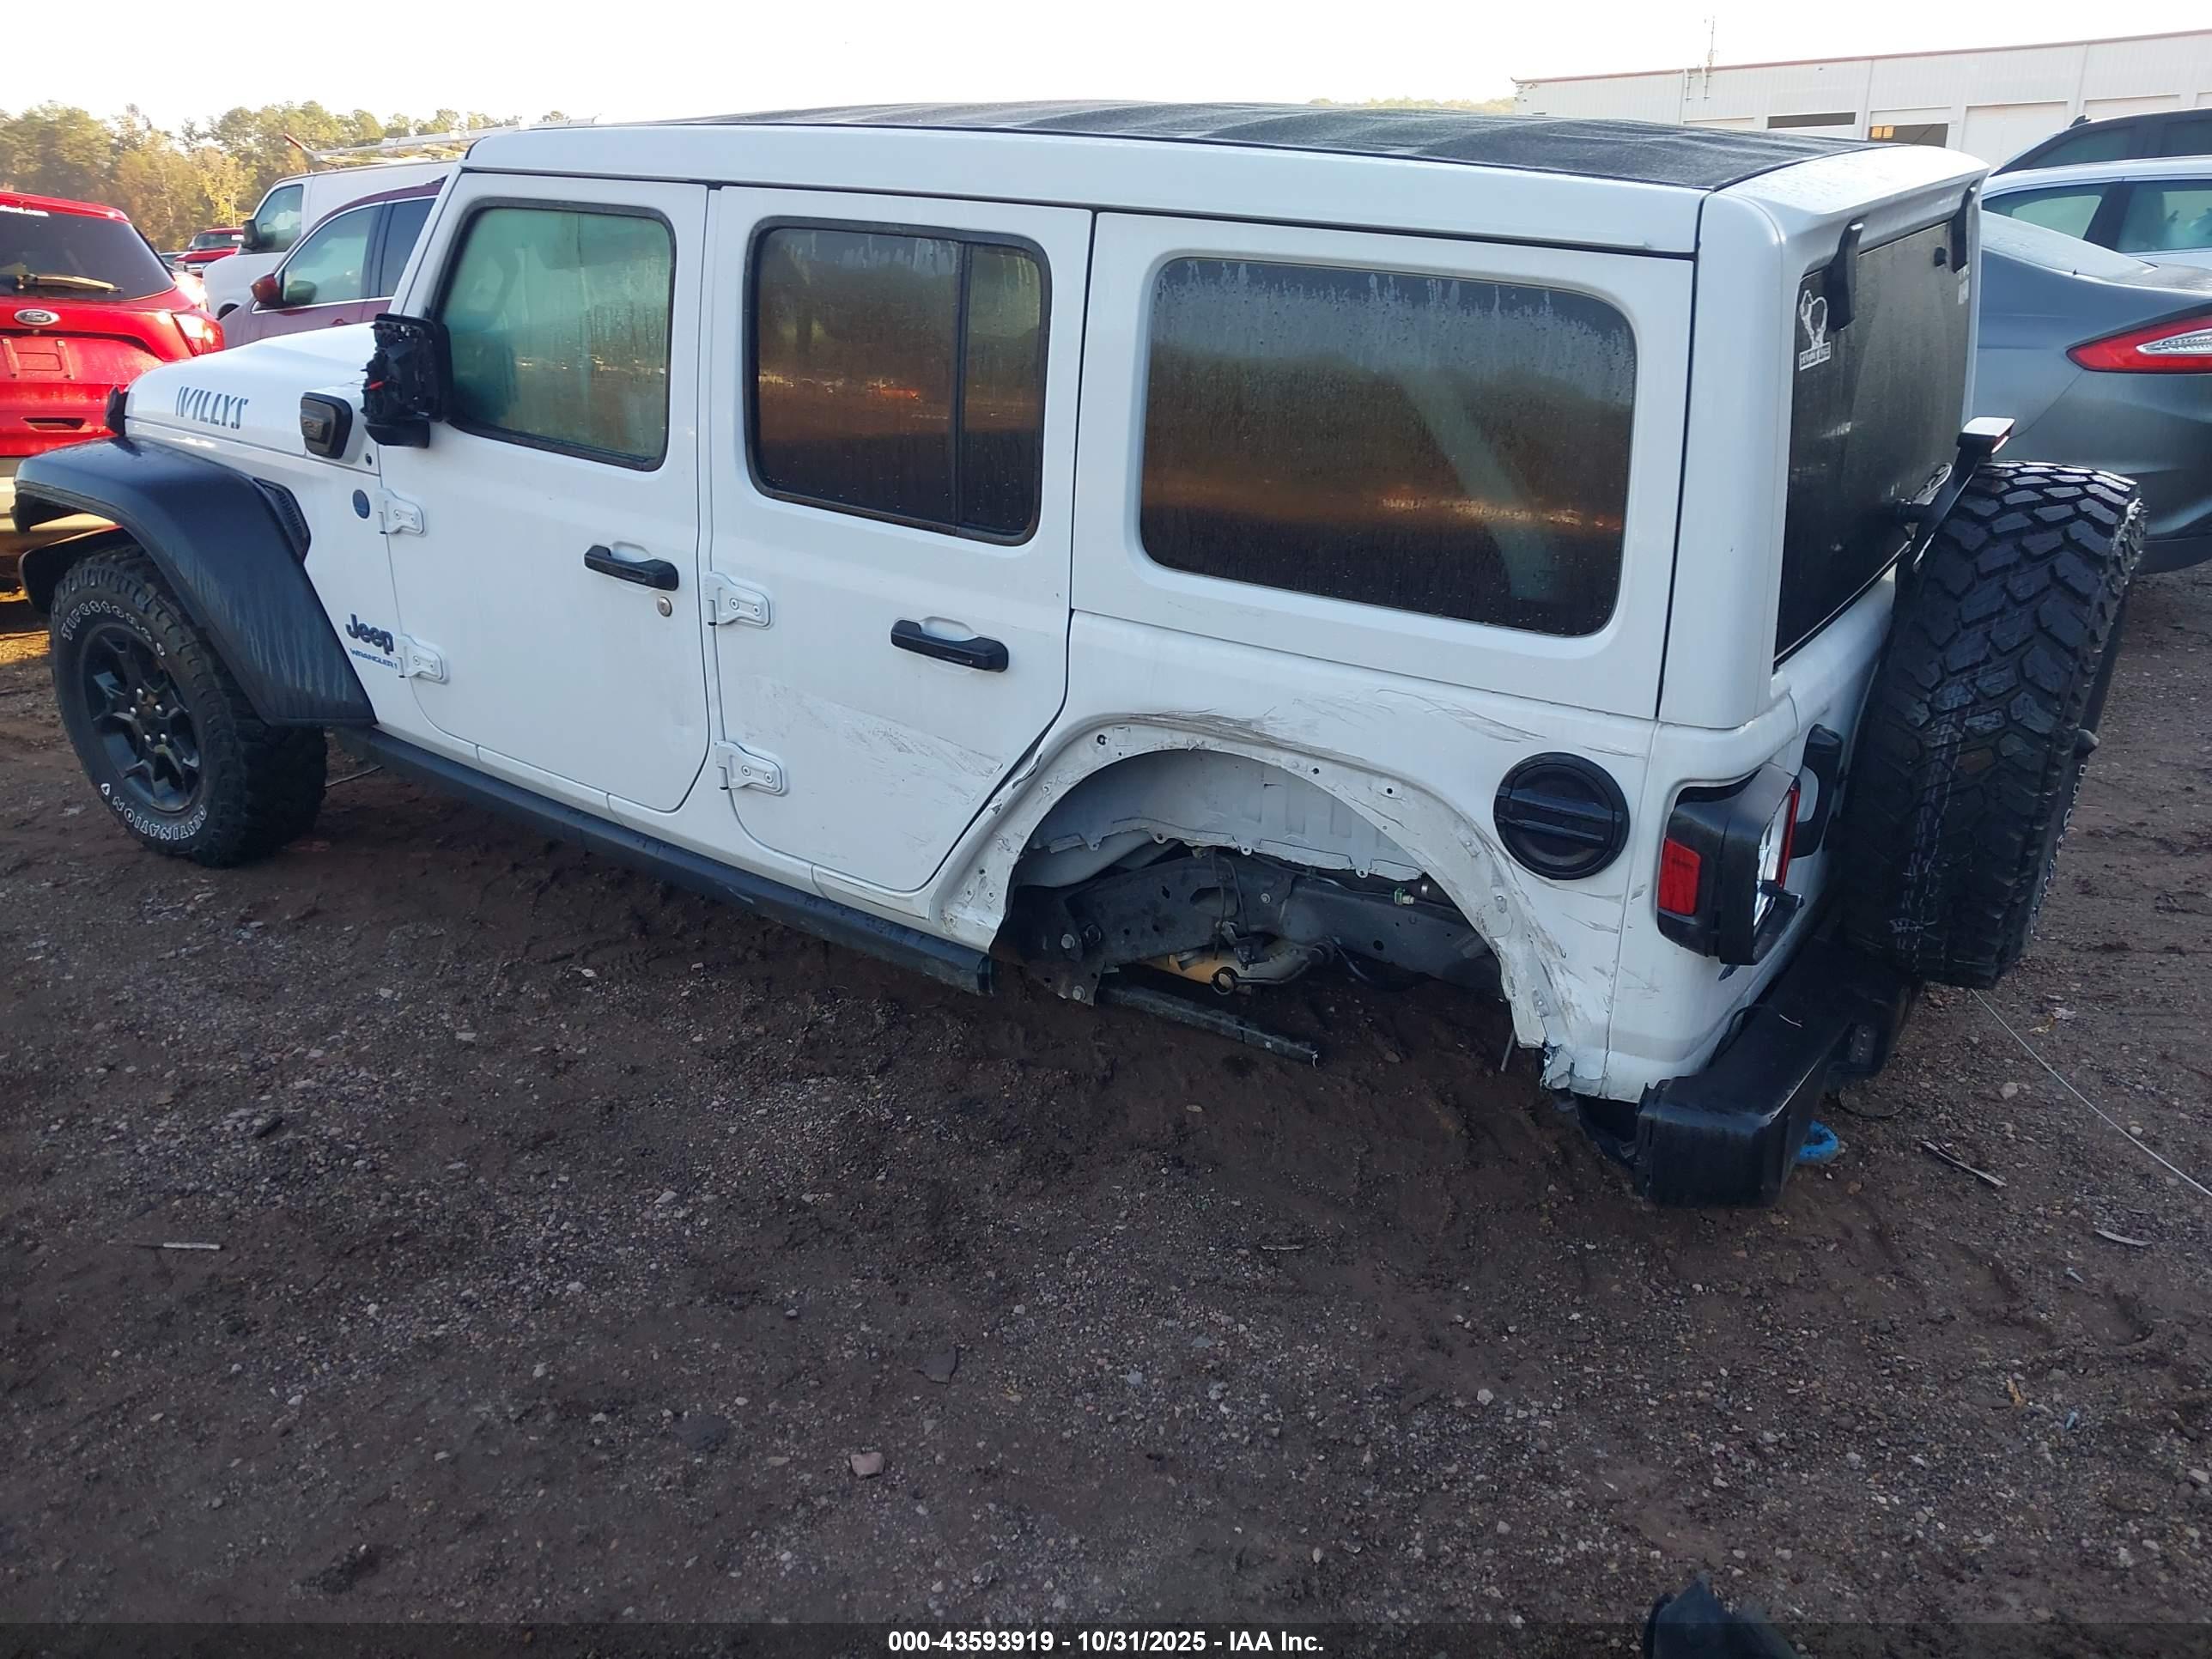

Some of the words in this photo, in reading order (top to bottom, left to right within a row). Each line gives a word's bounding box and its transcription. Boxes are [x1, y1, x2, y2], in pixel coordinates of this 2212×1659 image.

[175, 386, 249, 430] WILLYS
[345, 613, 394, 656] Jeep
[112, 795, 208, 842] DESTINATION
